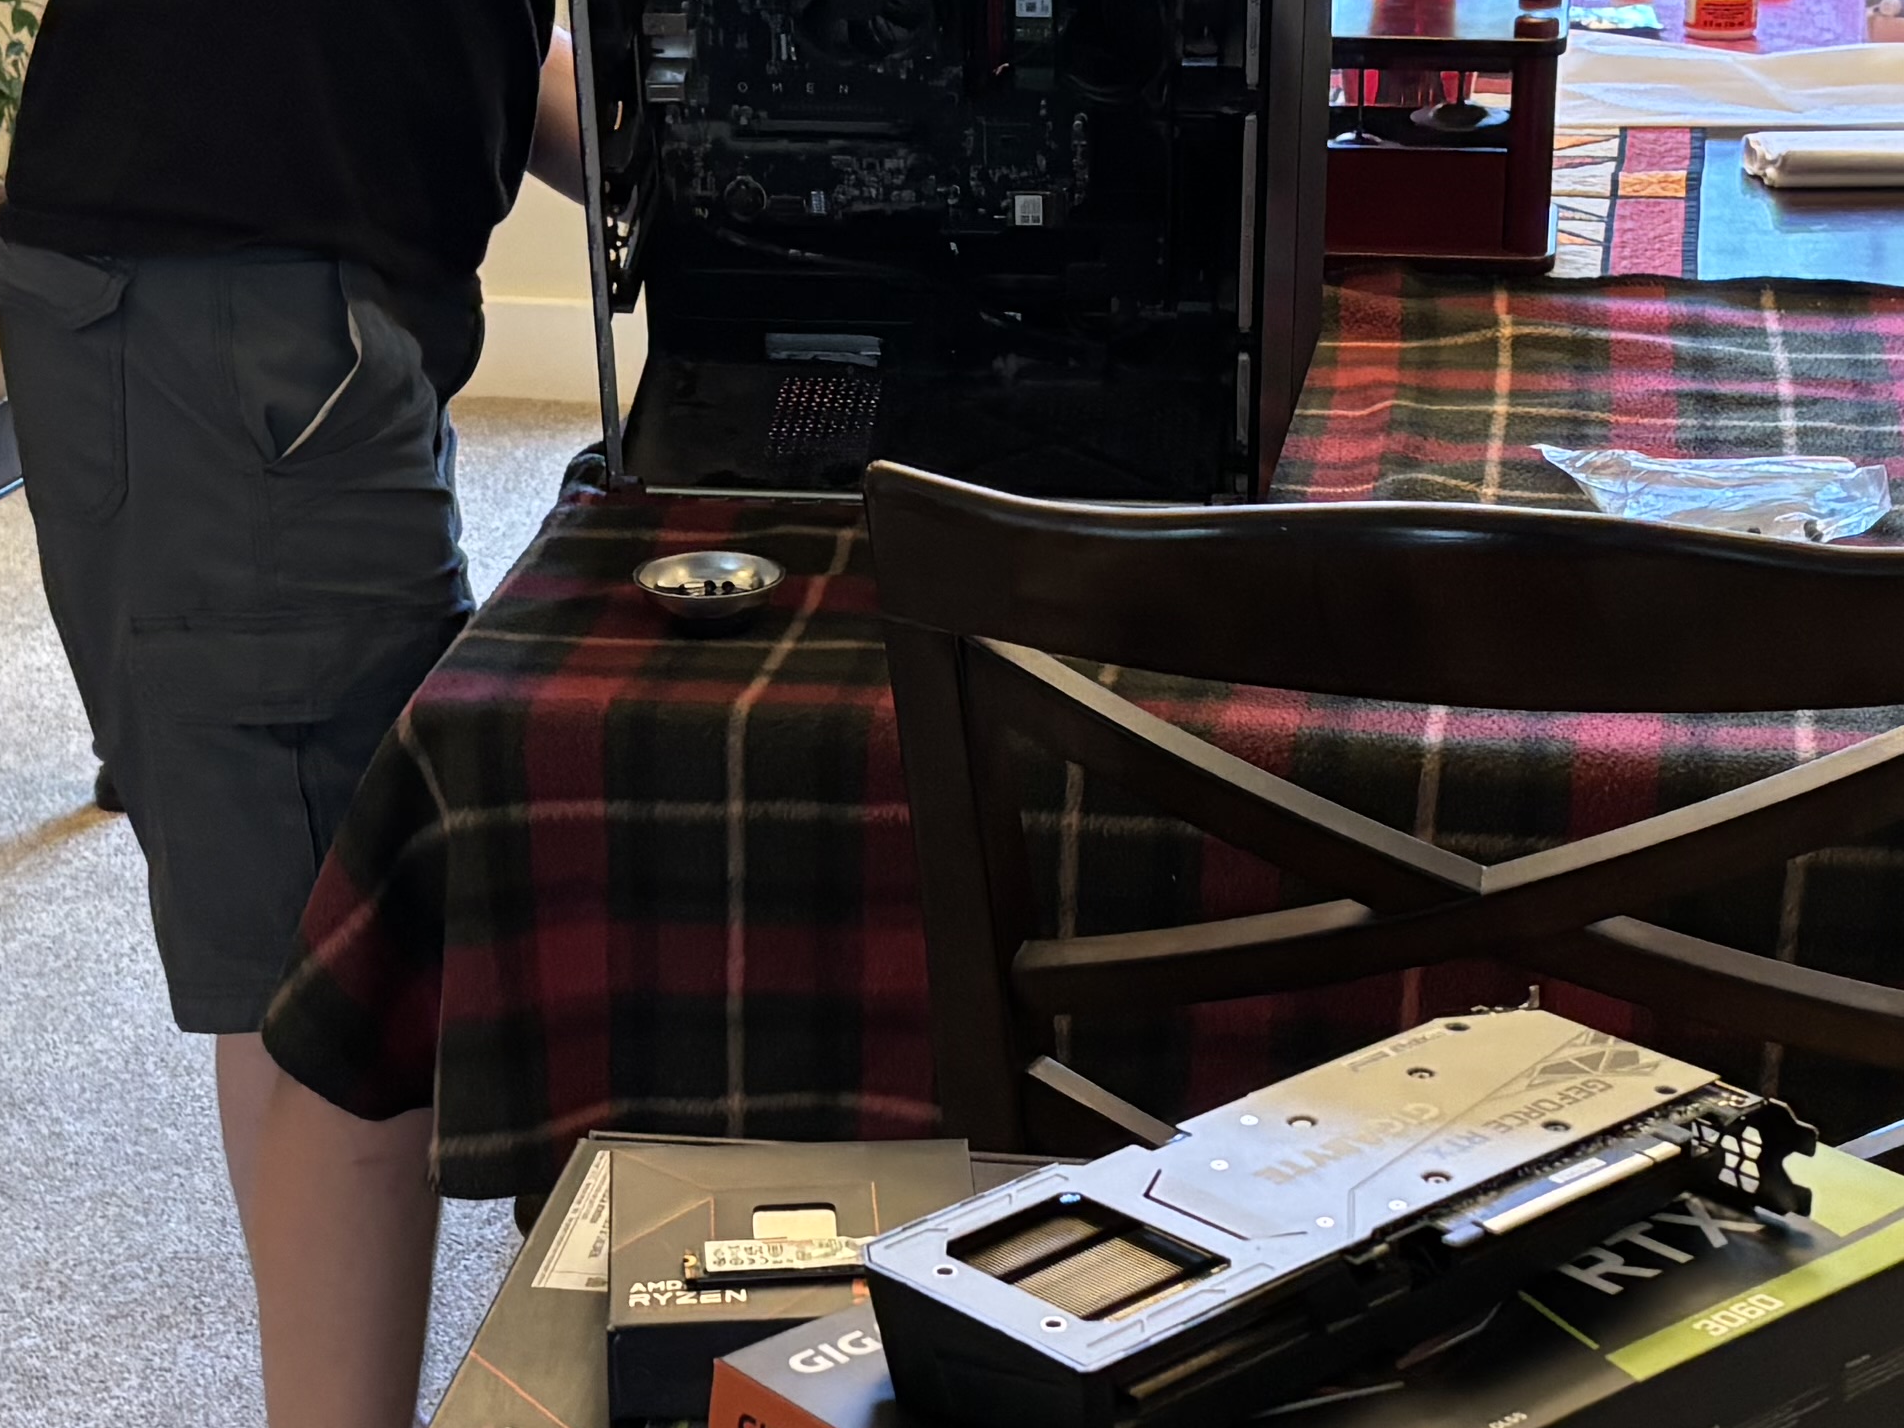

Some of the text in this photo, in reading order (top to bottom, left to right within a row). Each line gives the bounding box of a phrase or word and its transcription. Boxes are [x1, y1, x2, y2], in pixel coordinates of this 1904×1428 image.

[737, 81, 849, 94] OMEN
[1481, 1077, 1614, 1135] GEFORCE
[1558, 1191, 1764, 1295] RTX
[628, 1289, 748, 1308] RYZEN
[629, 1280, 683, 1292] AMD
[1692, 1293, 1785, 1337] 3060
[788, 1325, 883, 1373] GIG
